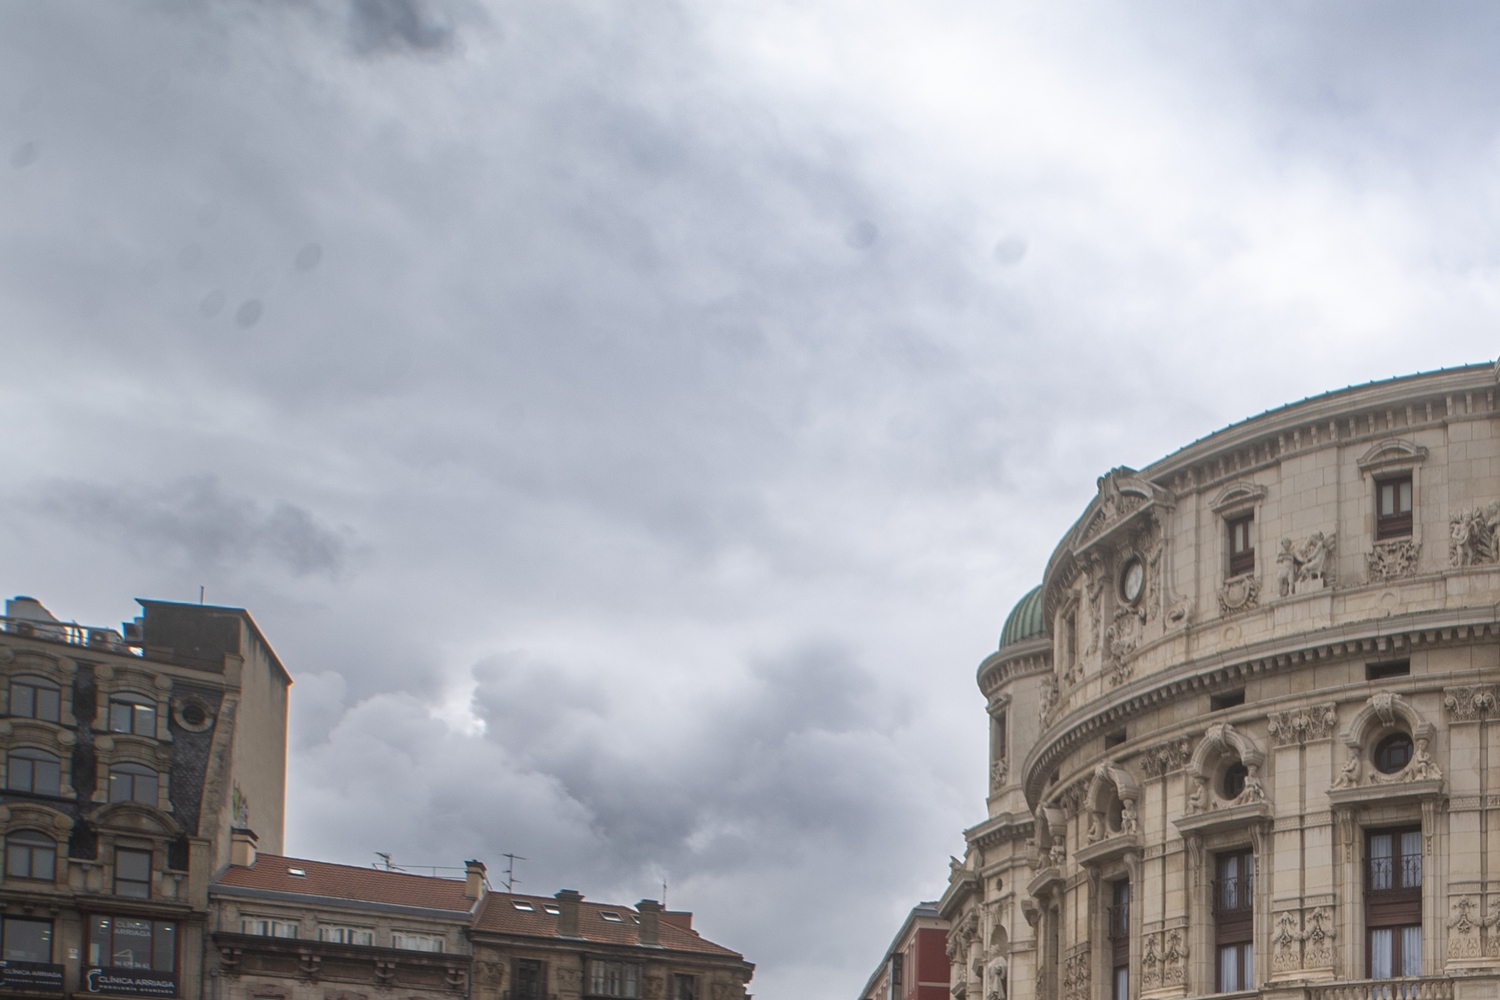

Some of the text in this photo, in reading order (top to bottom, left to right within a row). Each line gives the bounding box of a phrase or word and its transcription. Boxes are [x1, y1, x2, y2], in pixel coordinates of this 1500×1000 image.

[114, 929, 152, 938] ARRIAGA
[32, 970, 63, 979] ARRIAGA
[98, 975, 175, 989] CLÍNICA ARRIAGA
